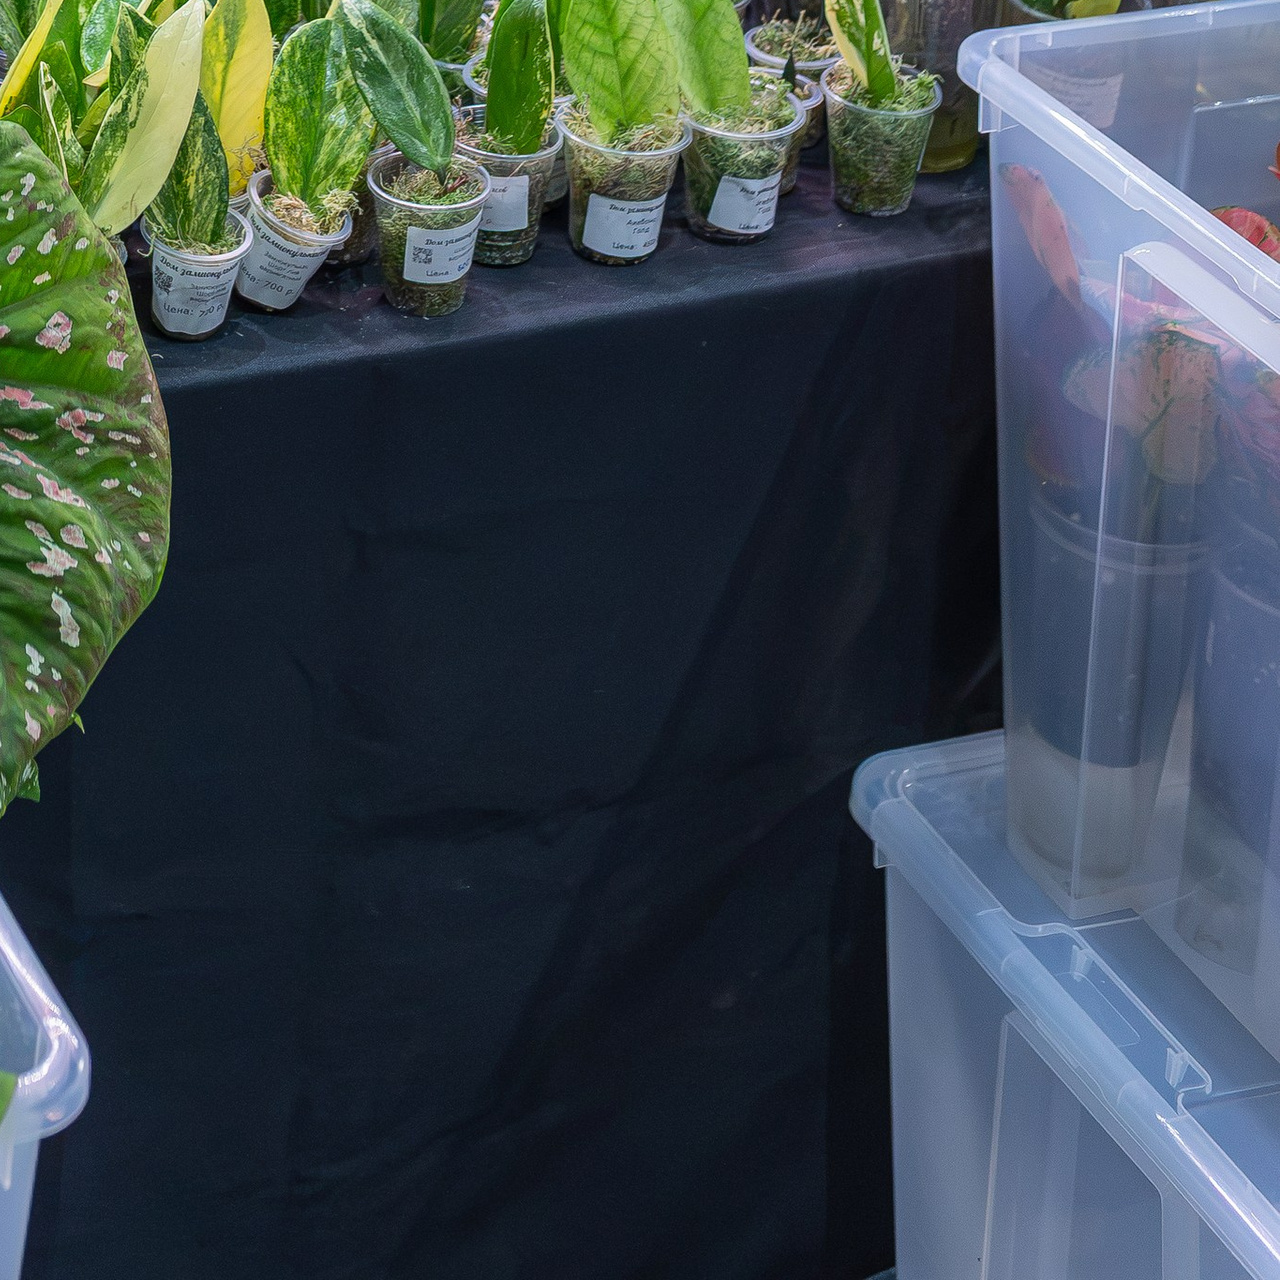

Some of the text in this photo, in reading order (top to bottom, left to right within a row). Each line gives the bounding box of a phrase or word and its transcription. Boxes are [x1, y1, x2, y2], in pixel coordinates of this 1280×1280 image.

[160, 256, 179, 272] Дом
[262, 280, 284, 293] 700
[163, 302, 194, 316] Цена:
